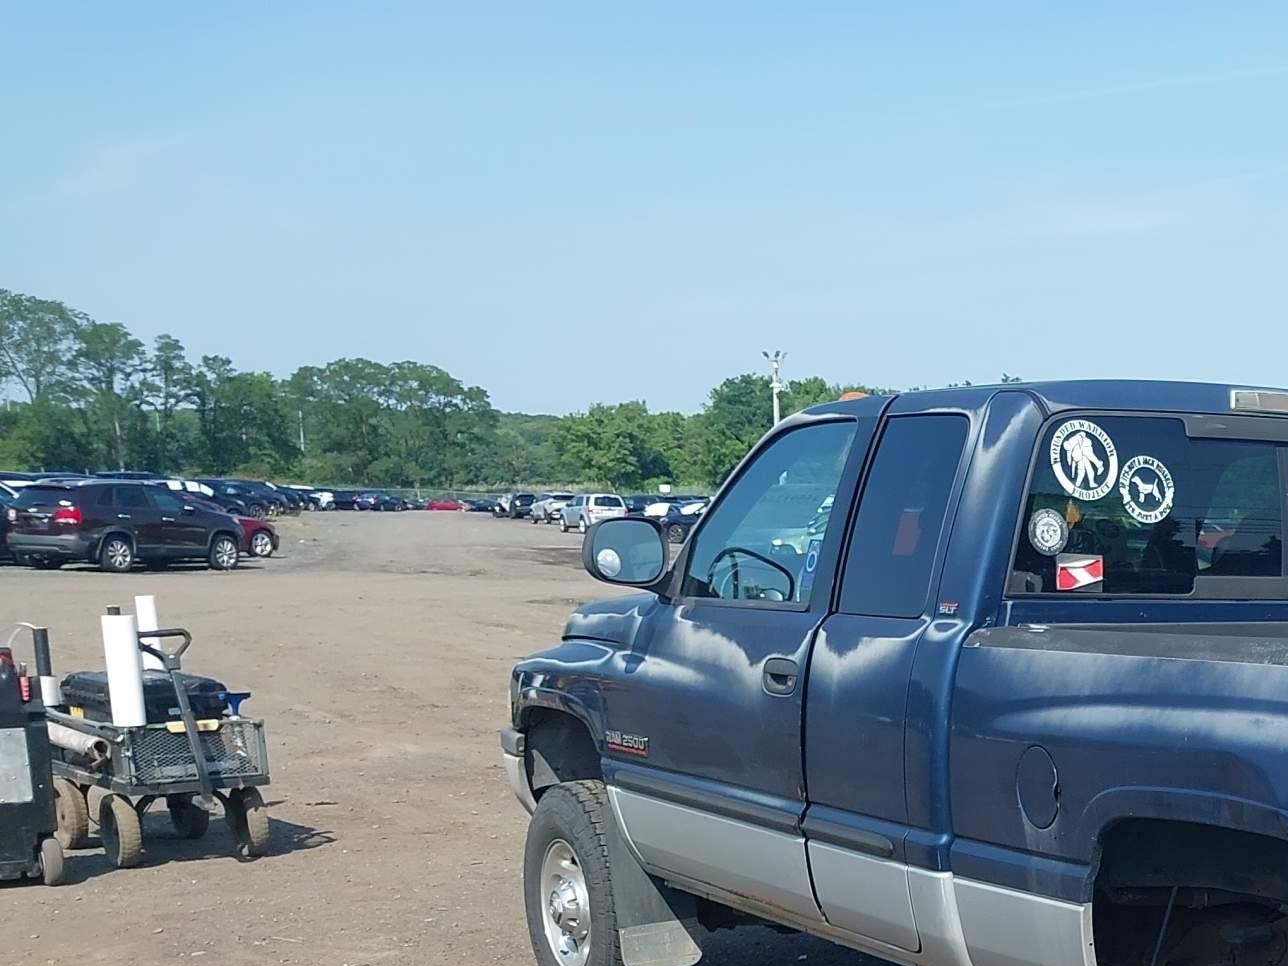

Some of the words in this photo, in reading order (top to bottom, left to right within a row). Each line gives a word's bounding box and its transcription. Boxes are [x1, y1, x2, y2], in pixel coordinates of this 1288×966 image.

[1053, 422, 1076, 464] WOUNDED
[1078, 421, 1115, 457] WARRIOR
[1072, 482, 1110, 500] PROJECT
[938, 606, 957, 615] SLT
[605, 730, 621, 745] RAM
[622, 734, 646, 750] 2500
